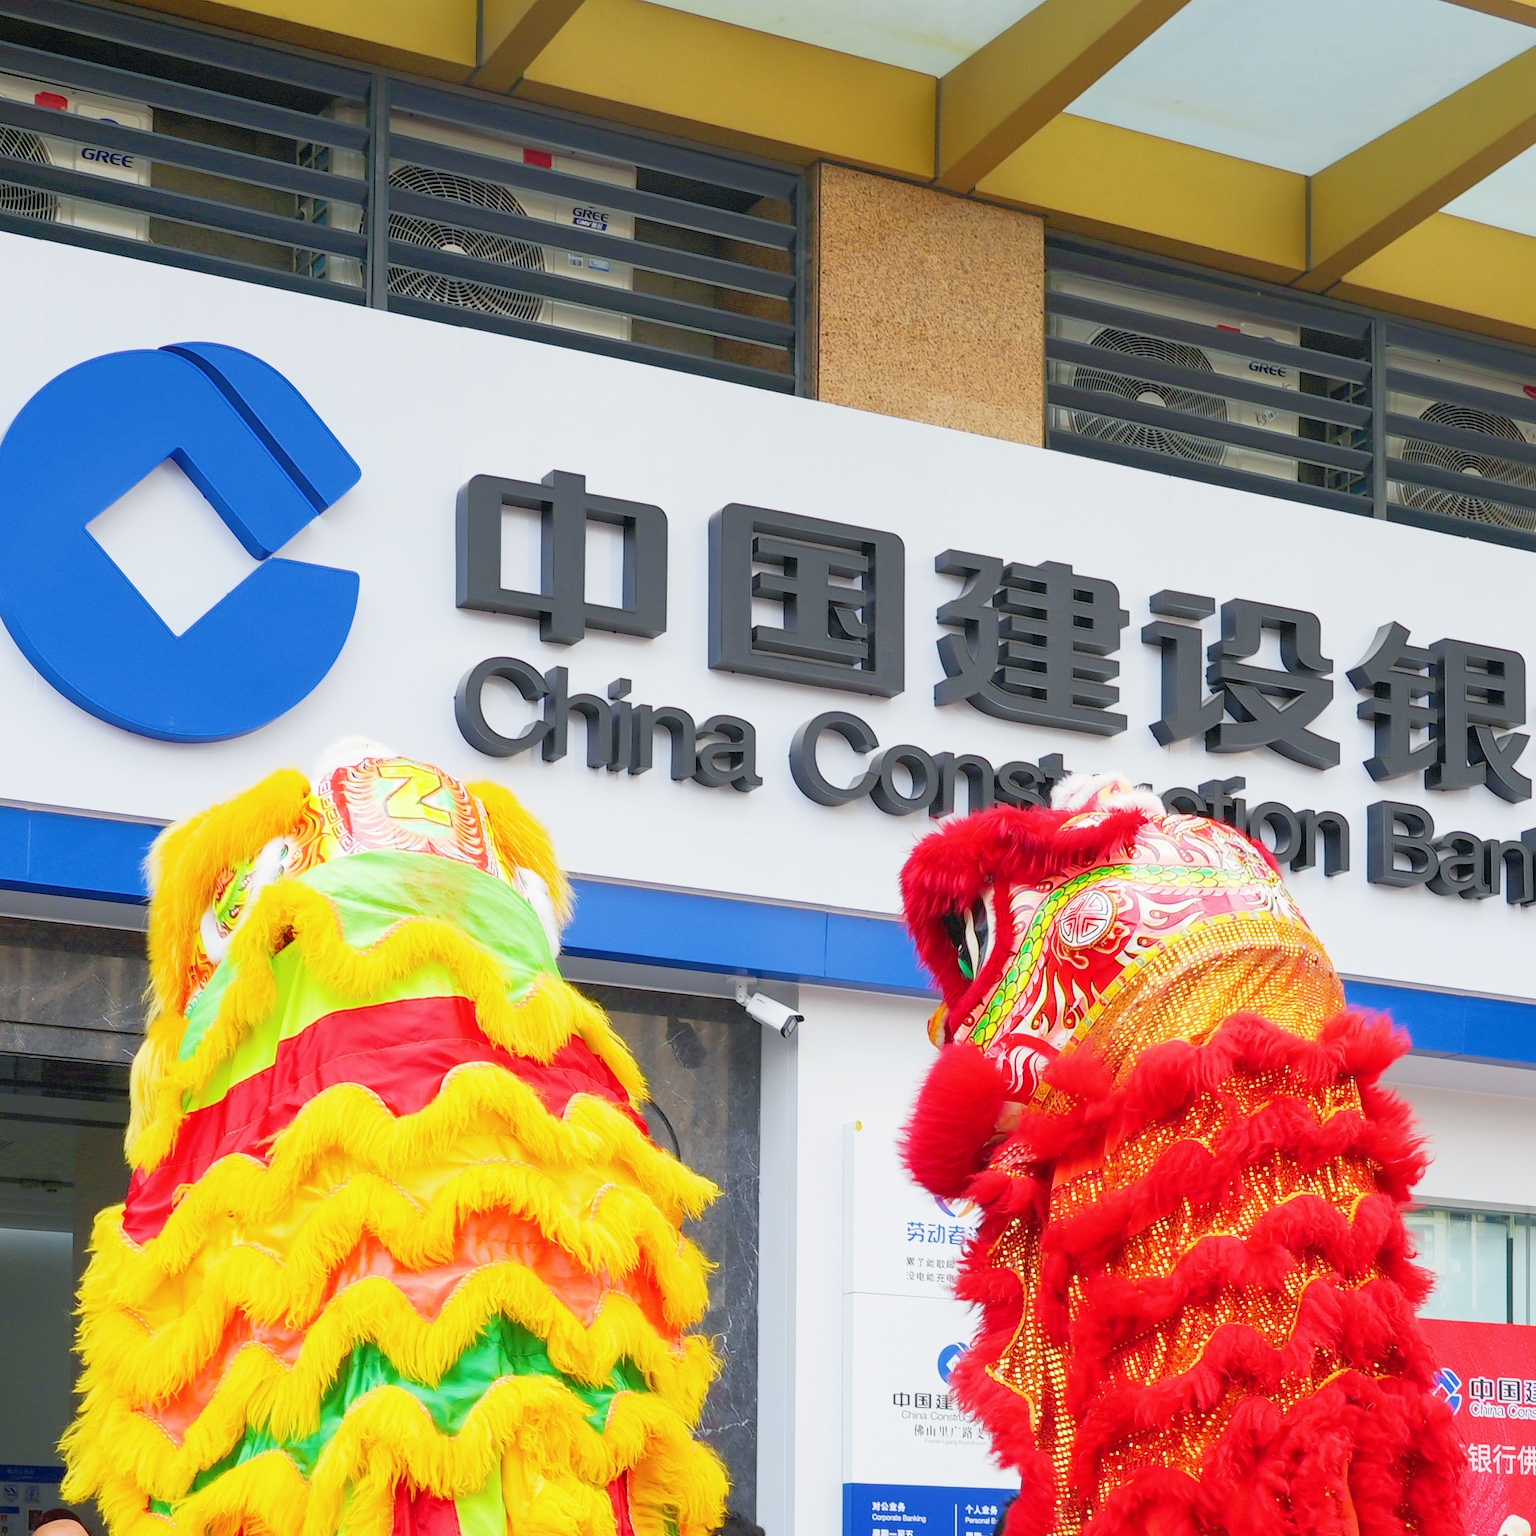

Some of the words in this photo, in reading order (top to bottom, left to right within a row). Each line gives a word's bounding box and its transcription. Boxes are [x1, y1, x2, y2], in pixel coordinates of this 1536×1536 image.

[81, 147, 134, 168] GREE
[572, 207, 610, 223] GREE
[1248, 361, 1287, 377] GREE
[454, 657, 762, 792] China
[791, 711, 1350, 877] Constction
[901, 1410, 927, 1420] China
[930, 1411, 974, 1423] Construct
[1470, 1402, 1505, 1417] China
[871, 1501, 906, 1513] 对公业务
[965, 1504, 998, 1516] 个人业务
[871, 1513, 902, 1523] Corporate
[902, 1514, 927, 1524] Banking
[965, 1516, 990, 1525] Personal
